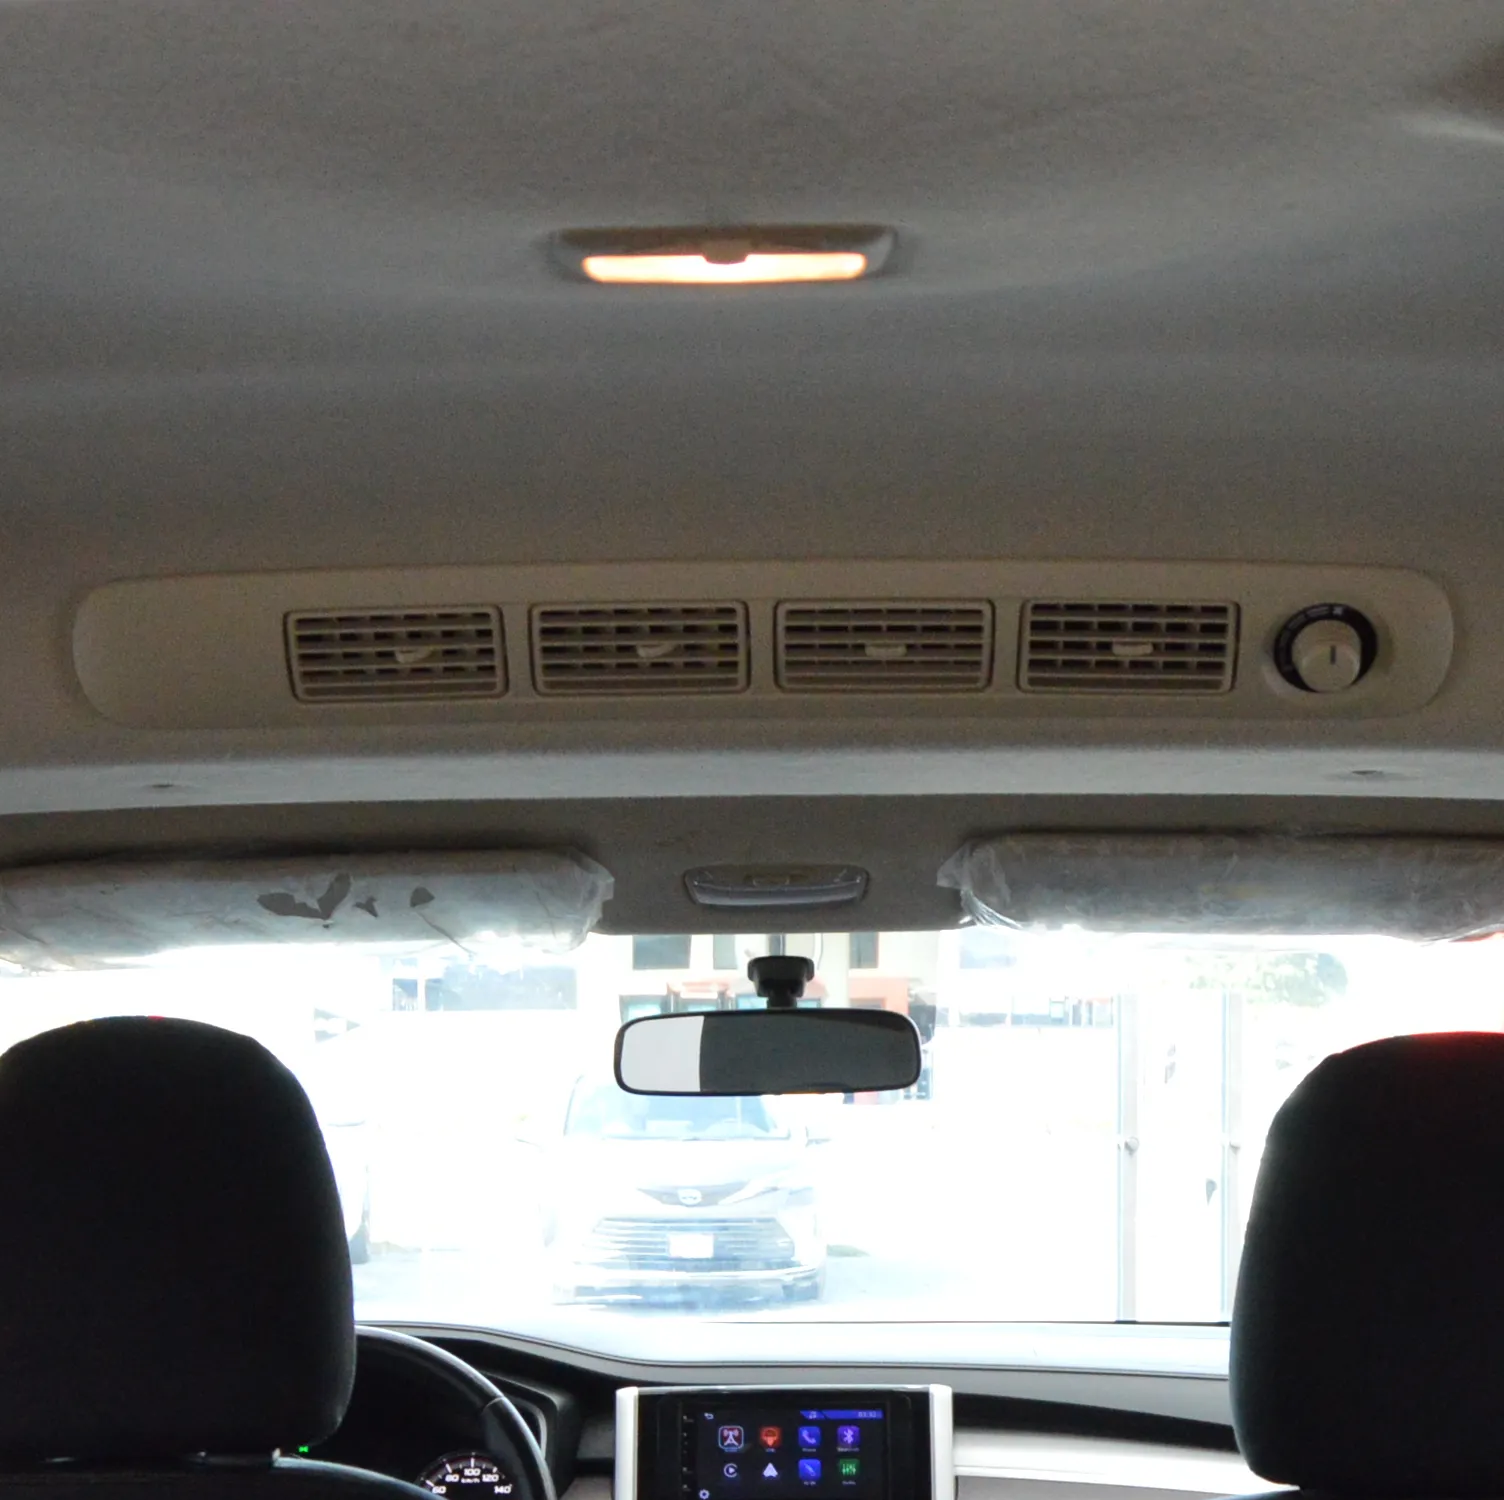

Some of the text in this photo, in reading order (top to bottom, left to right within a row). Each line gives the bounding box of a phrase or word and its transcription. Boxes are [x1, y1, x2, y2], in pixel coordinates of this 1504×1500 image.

[464, 1468, 481, 1476] 100
[445, 1474, 459, 1482] 80
[481, 1474, 499, 1482] 120
[432, 1486, 447, 1494] 60
[494, 1486, 511, 1494] 140
